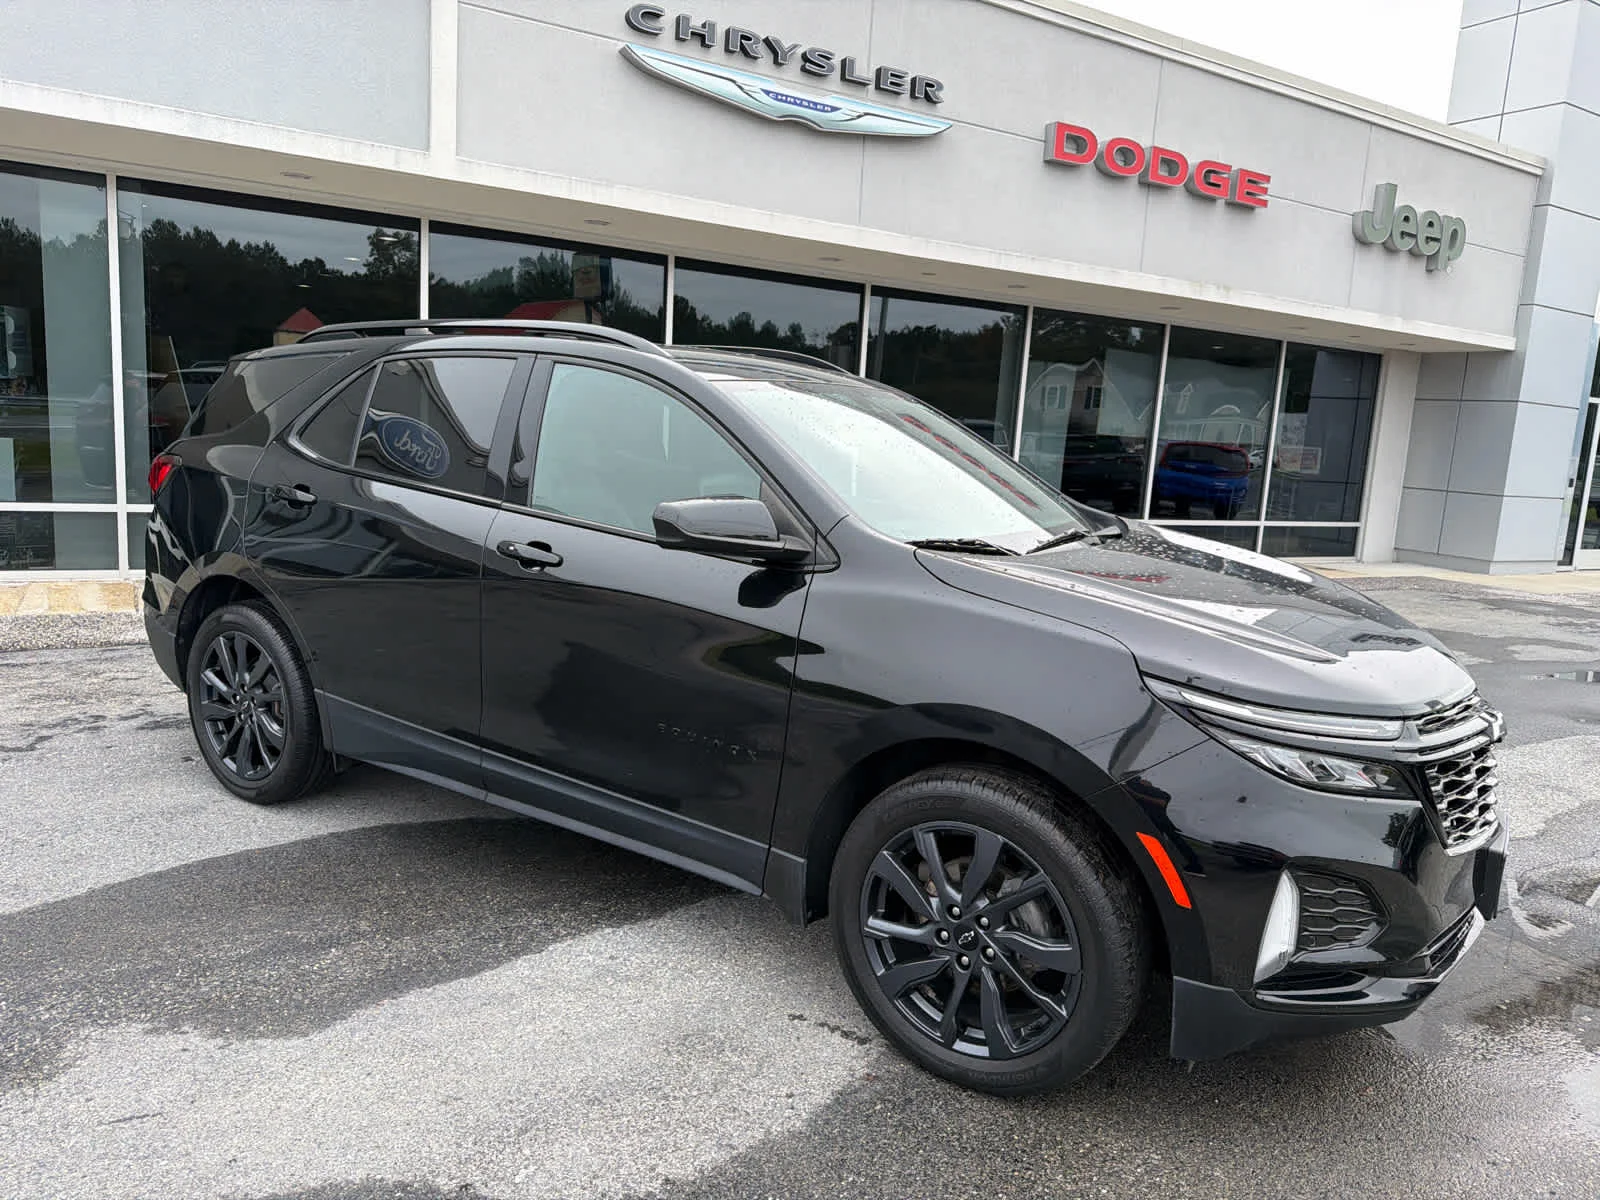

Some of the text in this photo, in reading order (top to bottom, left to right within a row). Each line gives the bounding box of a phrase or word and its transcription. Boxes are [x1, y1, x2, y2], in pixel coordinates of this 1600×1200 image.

[625, 3, 945, 104] CHRYSLER
[768, 92, 832, 113] CHRYSLER
[1043, 121, 1271, 209] DODGE
[1352, 183, 1466, 272] Jeep
